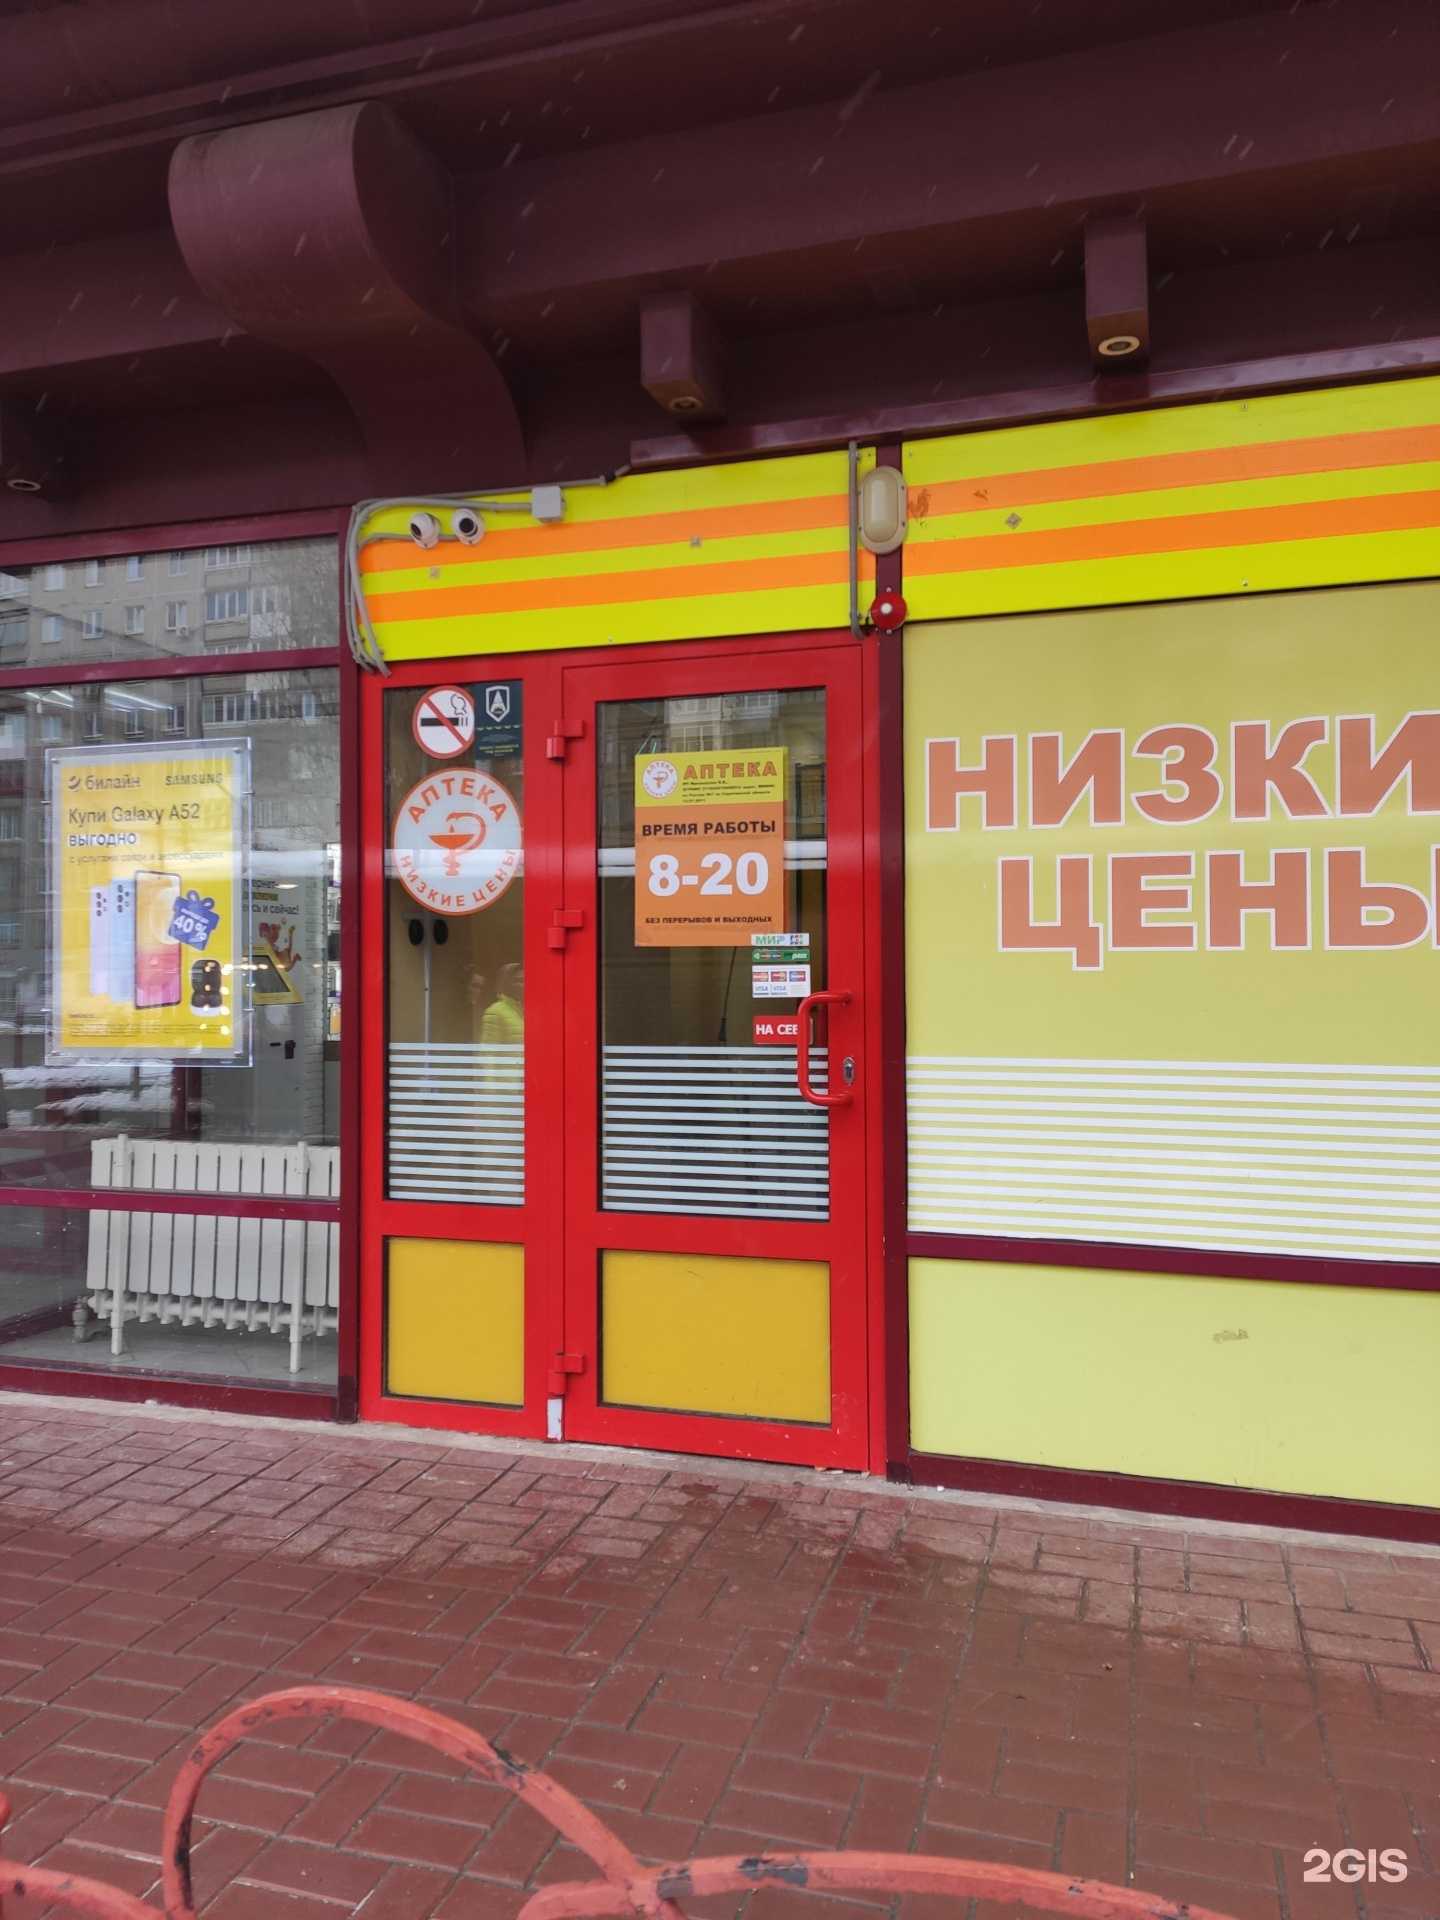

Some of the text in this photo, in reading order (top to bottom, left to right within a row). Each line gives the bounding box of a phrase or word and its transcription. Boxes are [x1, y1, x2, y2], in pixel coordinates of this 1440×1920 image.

[683, 760, 778, 780] АПТЕКА
[925, 709, 1440, 833] НИЗКИ
[85, 775, 141, 790] билайн
[165, 773, 224, 786] SAMSUNG
[407, 777, 507, 824] АПТЕКА
[69, 803, 201, 828] Купи Galaxy A52
[642, 820, 776, 837] ВРЕМЯ РАБОТЫ
[69, 833, 137, 848] выгодно
[400, 848, 517, 908] НИЗКИЕ ЦЕНЫ
[648, 852, 769, 897] 8-20
[662, 916, 713, 924] ПЕРЕРЫВОВ
[723, 915, 773, 924] ВЫХОДНЫХ
[755, 934, 785, 945] МИР
[756, 1024, 774, 1035] НА
